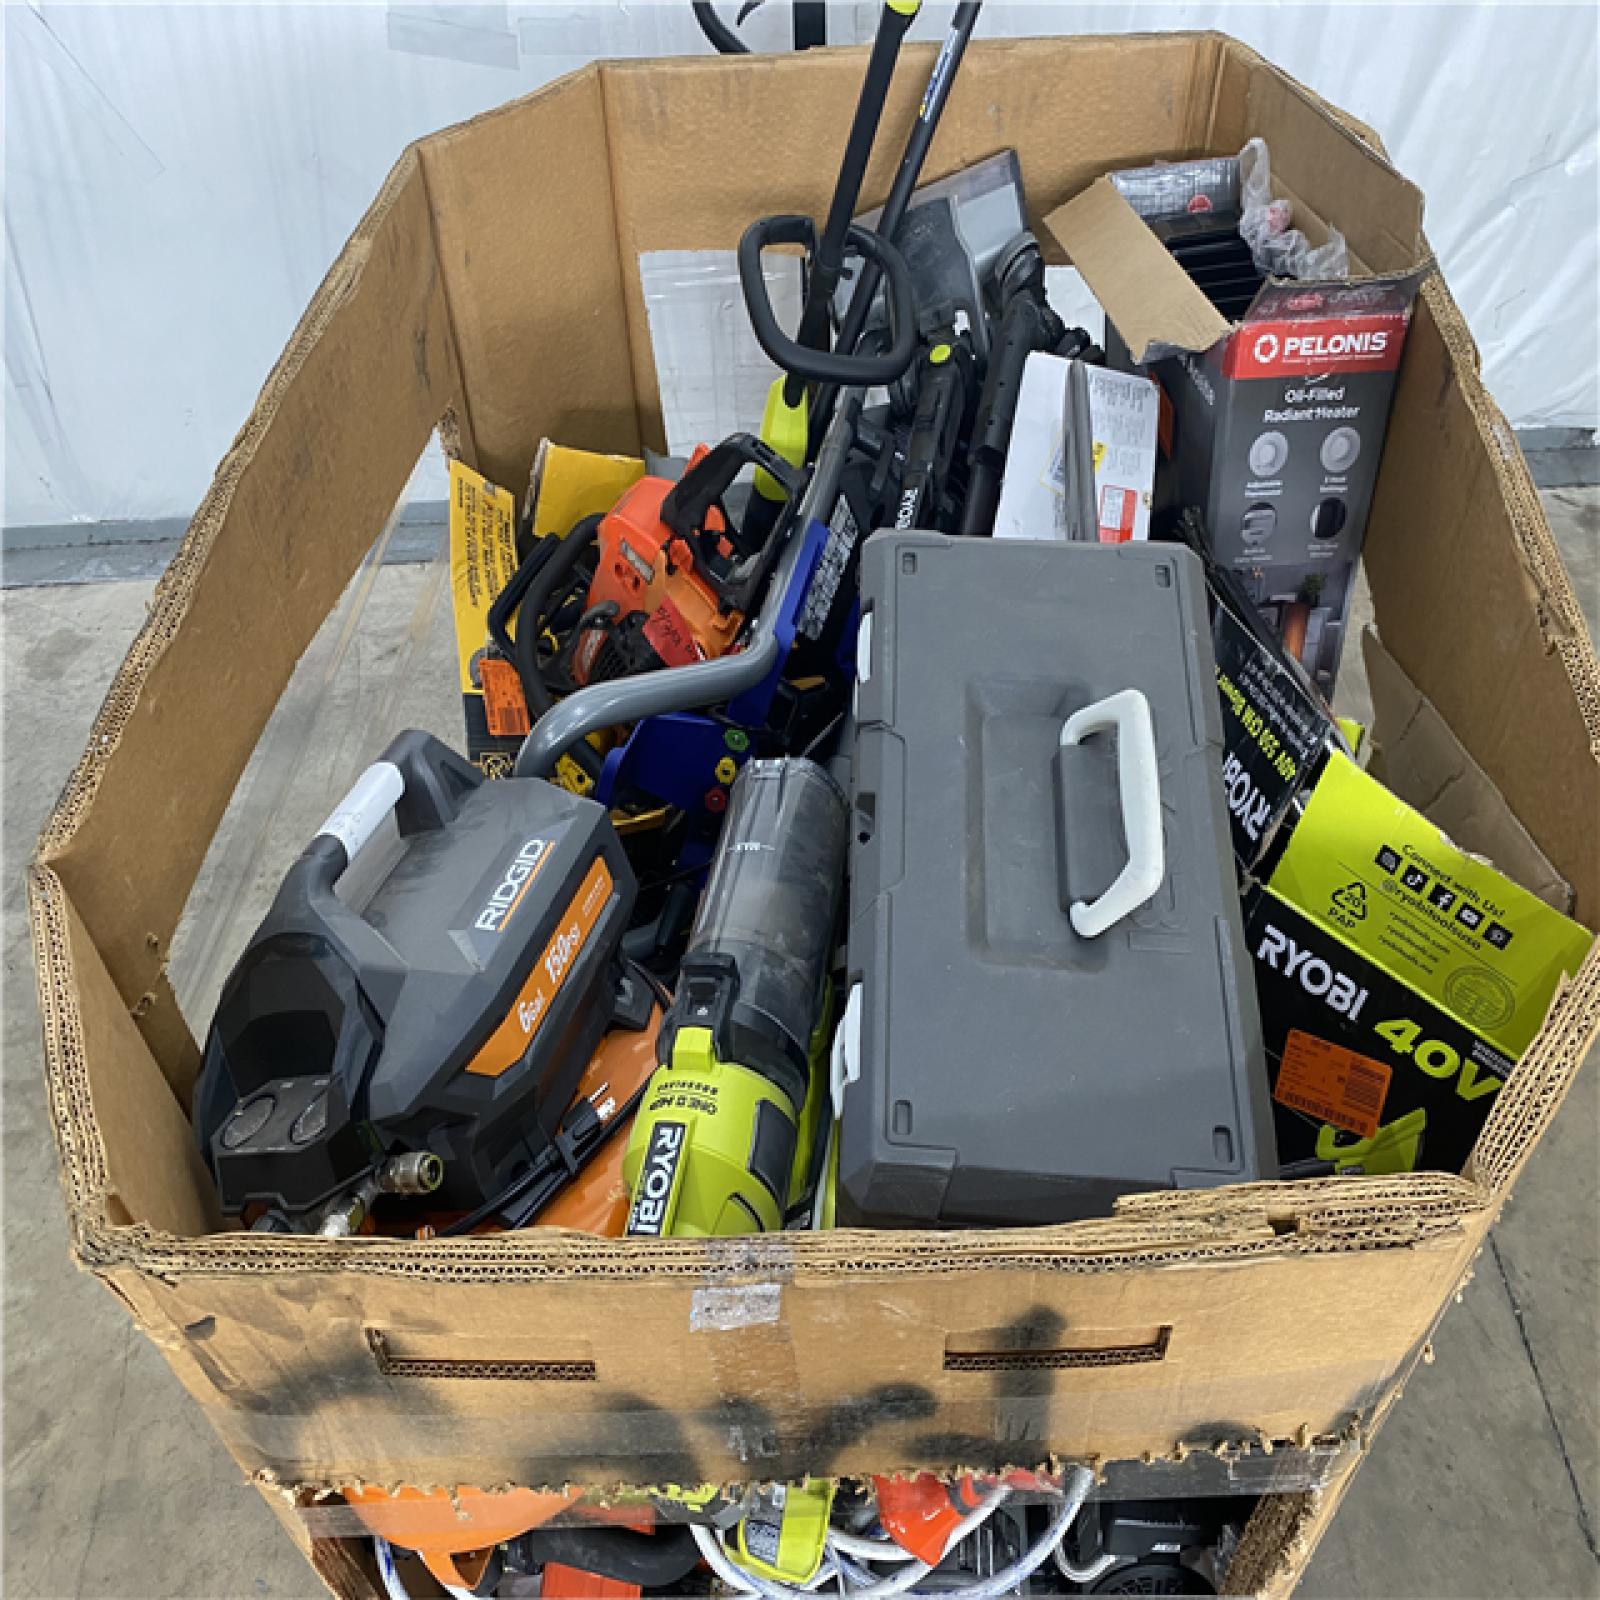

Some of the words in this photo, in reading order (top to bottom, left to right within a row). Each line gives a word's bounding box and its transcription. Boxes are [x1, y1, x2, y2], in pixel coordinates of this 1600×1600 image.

[1284, 331, 1389, 357] PELONIS
[1263, 407, 1313, 422] Radiant
[1315, 406, 1361, 419] Heater
[1284, 387, 1345, 403] Oil-Filled
[474, 839, 547, 931] RIDGID
[1402, 843, 1453, 883] Connect
[1453, 881, 1481, 903] with
[1327, 905, 1357, 929] PAP
[1256, 922, 1370, 1022] RYOBI
[1373, 1017, 1505, 1101] 40V
[634, 1125, 684, 1235] RYOBI
